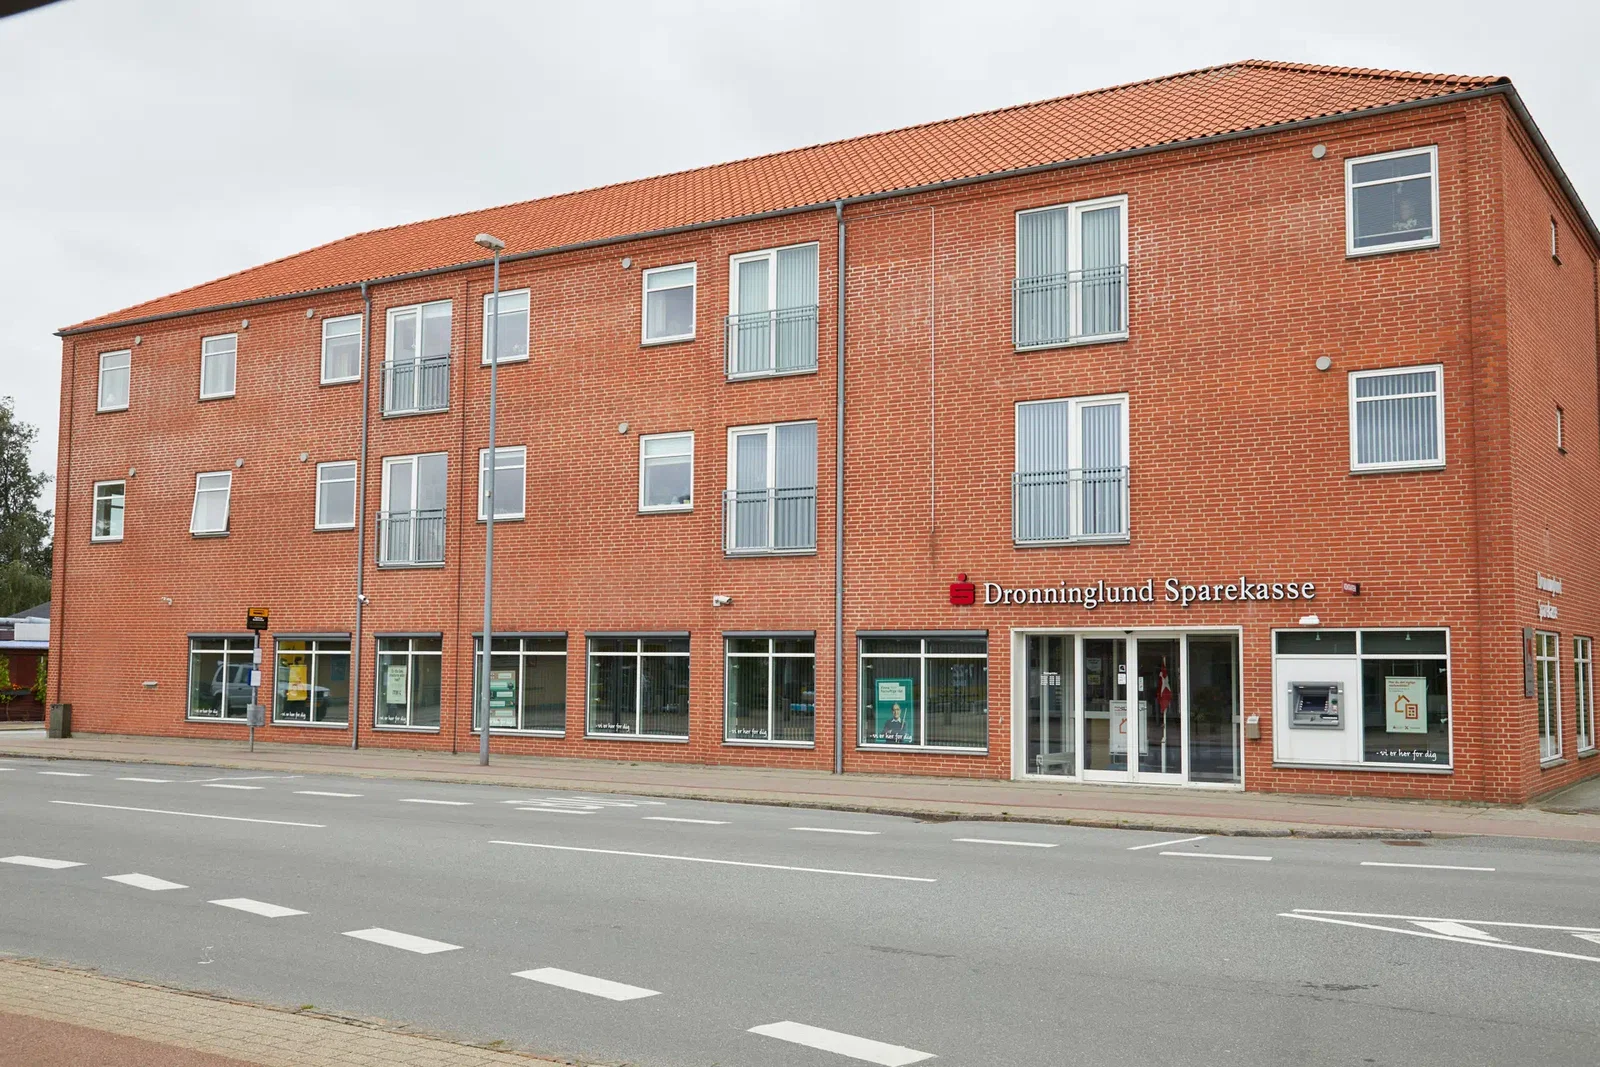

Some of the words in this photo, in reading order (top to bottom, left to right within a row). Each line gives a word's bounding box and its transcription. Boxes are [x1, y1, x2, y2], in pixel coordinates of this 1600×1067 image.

[983, 578, 1154, 609] Dronninglund
[1164, 576, 1315, 607] Sparekasse
[1412, 749, 1424, 761] for
[1424, 750, 1437, 762] dig
